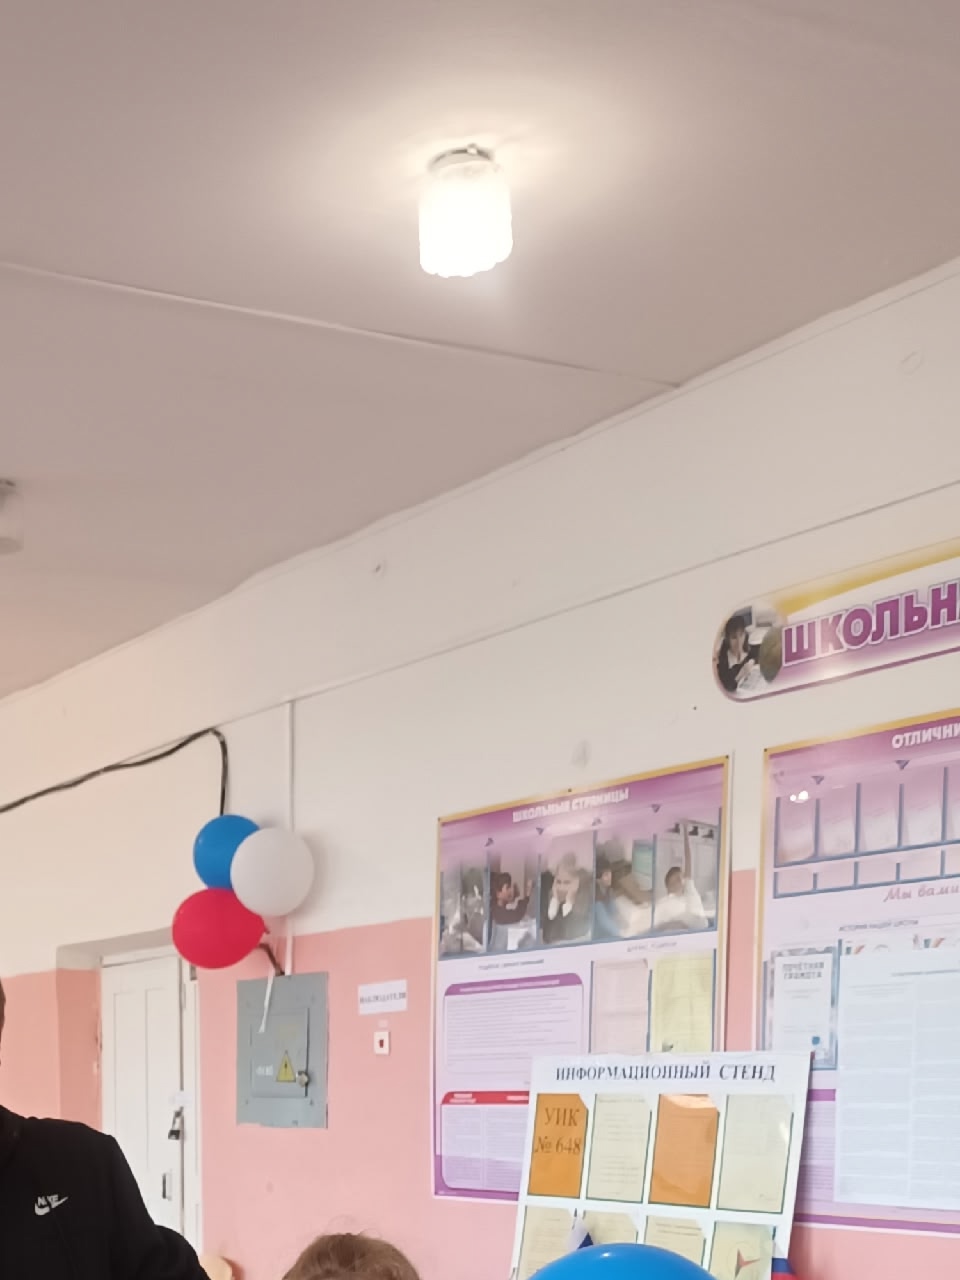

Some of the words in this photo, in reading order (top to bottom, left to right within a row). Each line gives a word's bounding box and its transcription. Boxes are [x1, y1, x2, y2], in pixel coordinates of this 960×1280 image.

[783, 580, 960, 666] ШКОЛЬН
[555, 1061, 711, 1082] ИНФОРМАЦИОННЫЙ
[718, 1064, 777, 1083] СТЕНД
[544, 1106, 581, 1127] УИК
